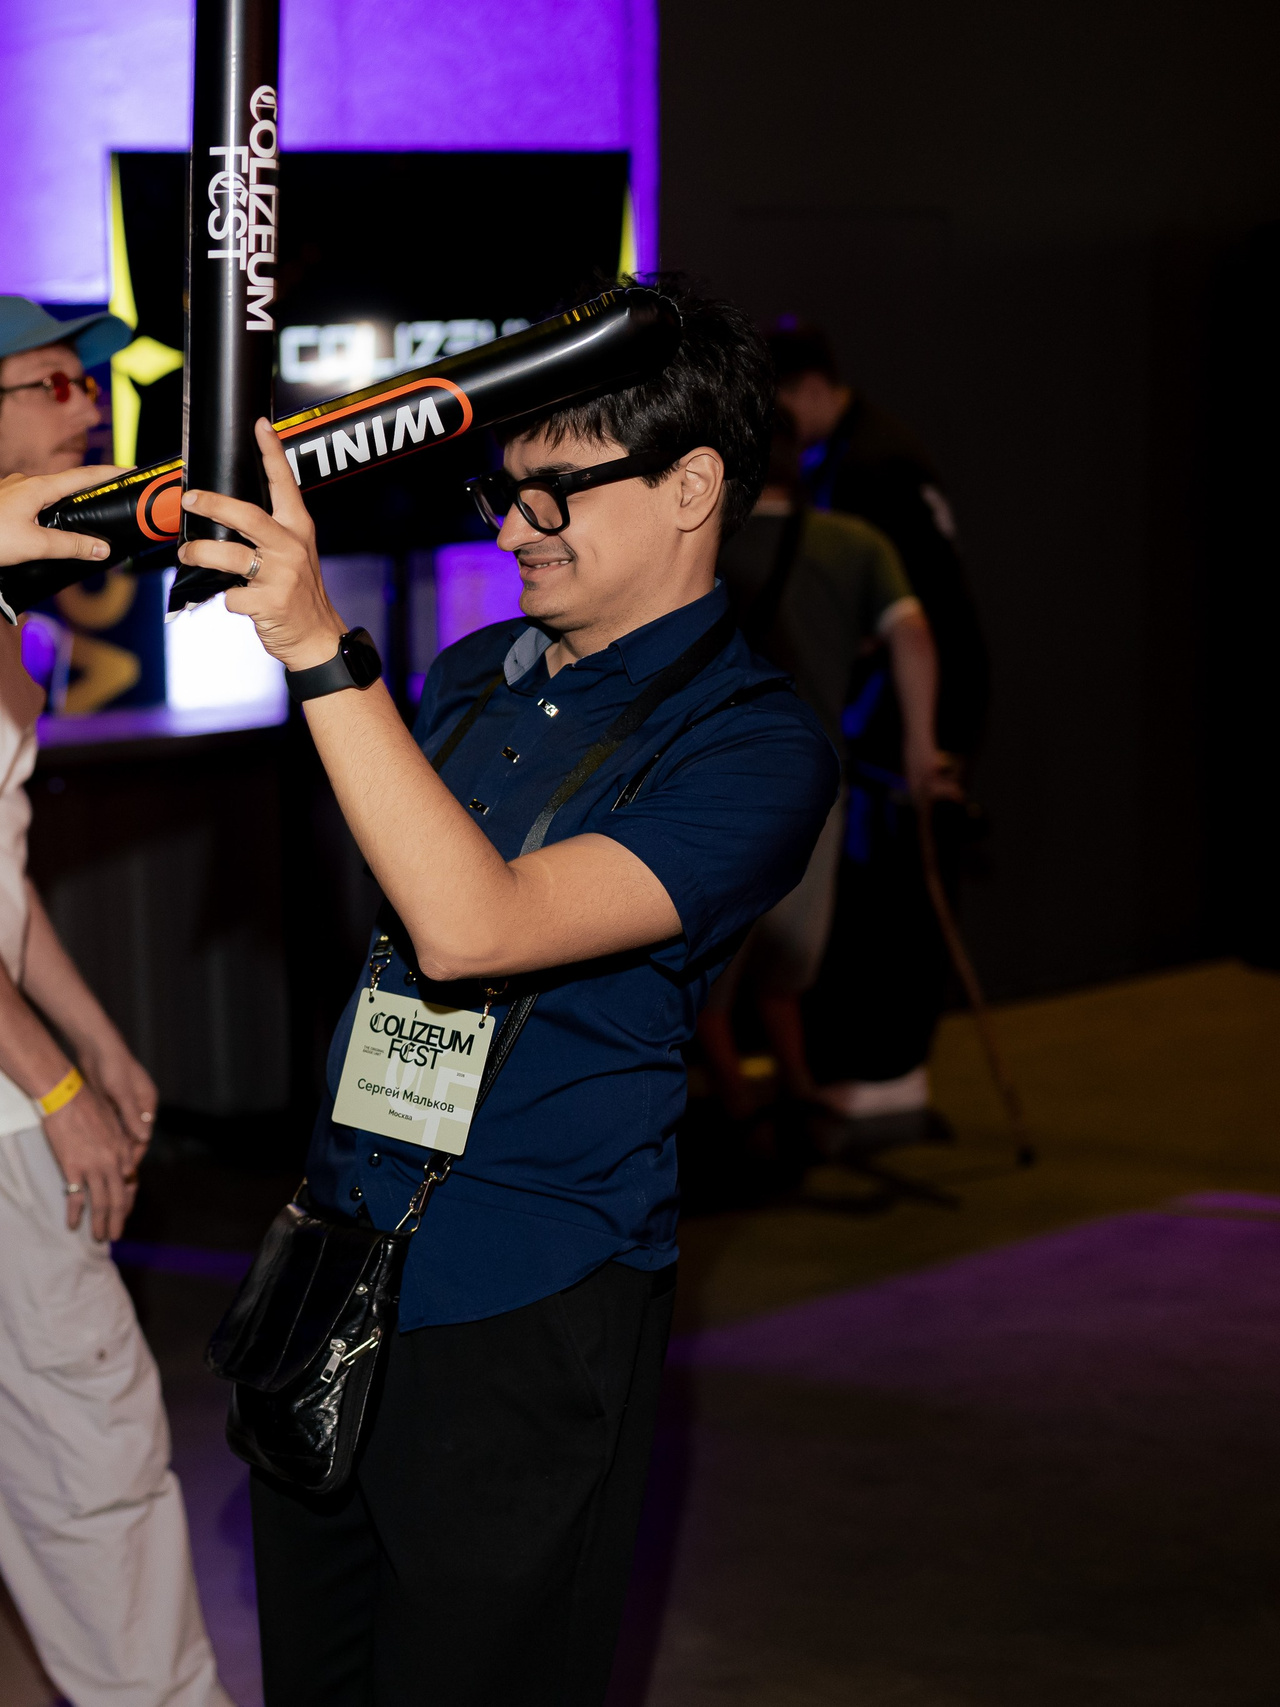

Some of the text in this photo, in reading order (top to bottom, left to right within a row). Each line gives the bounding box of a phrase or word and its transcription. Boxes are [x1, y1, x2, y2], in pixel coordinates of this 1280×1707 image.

[207, 145, 249, 271] FEST
[246, 85, 278, 331] COLIZEUM
[370, 1010, 475, 1056] COLIZEUM
[387, 1038, 444, 1070] FEST
[357, 1078, 455, 1113] Сергей Мальков
[388, 1108, 413, 1121] Москва
